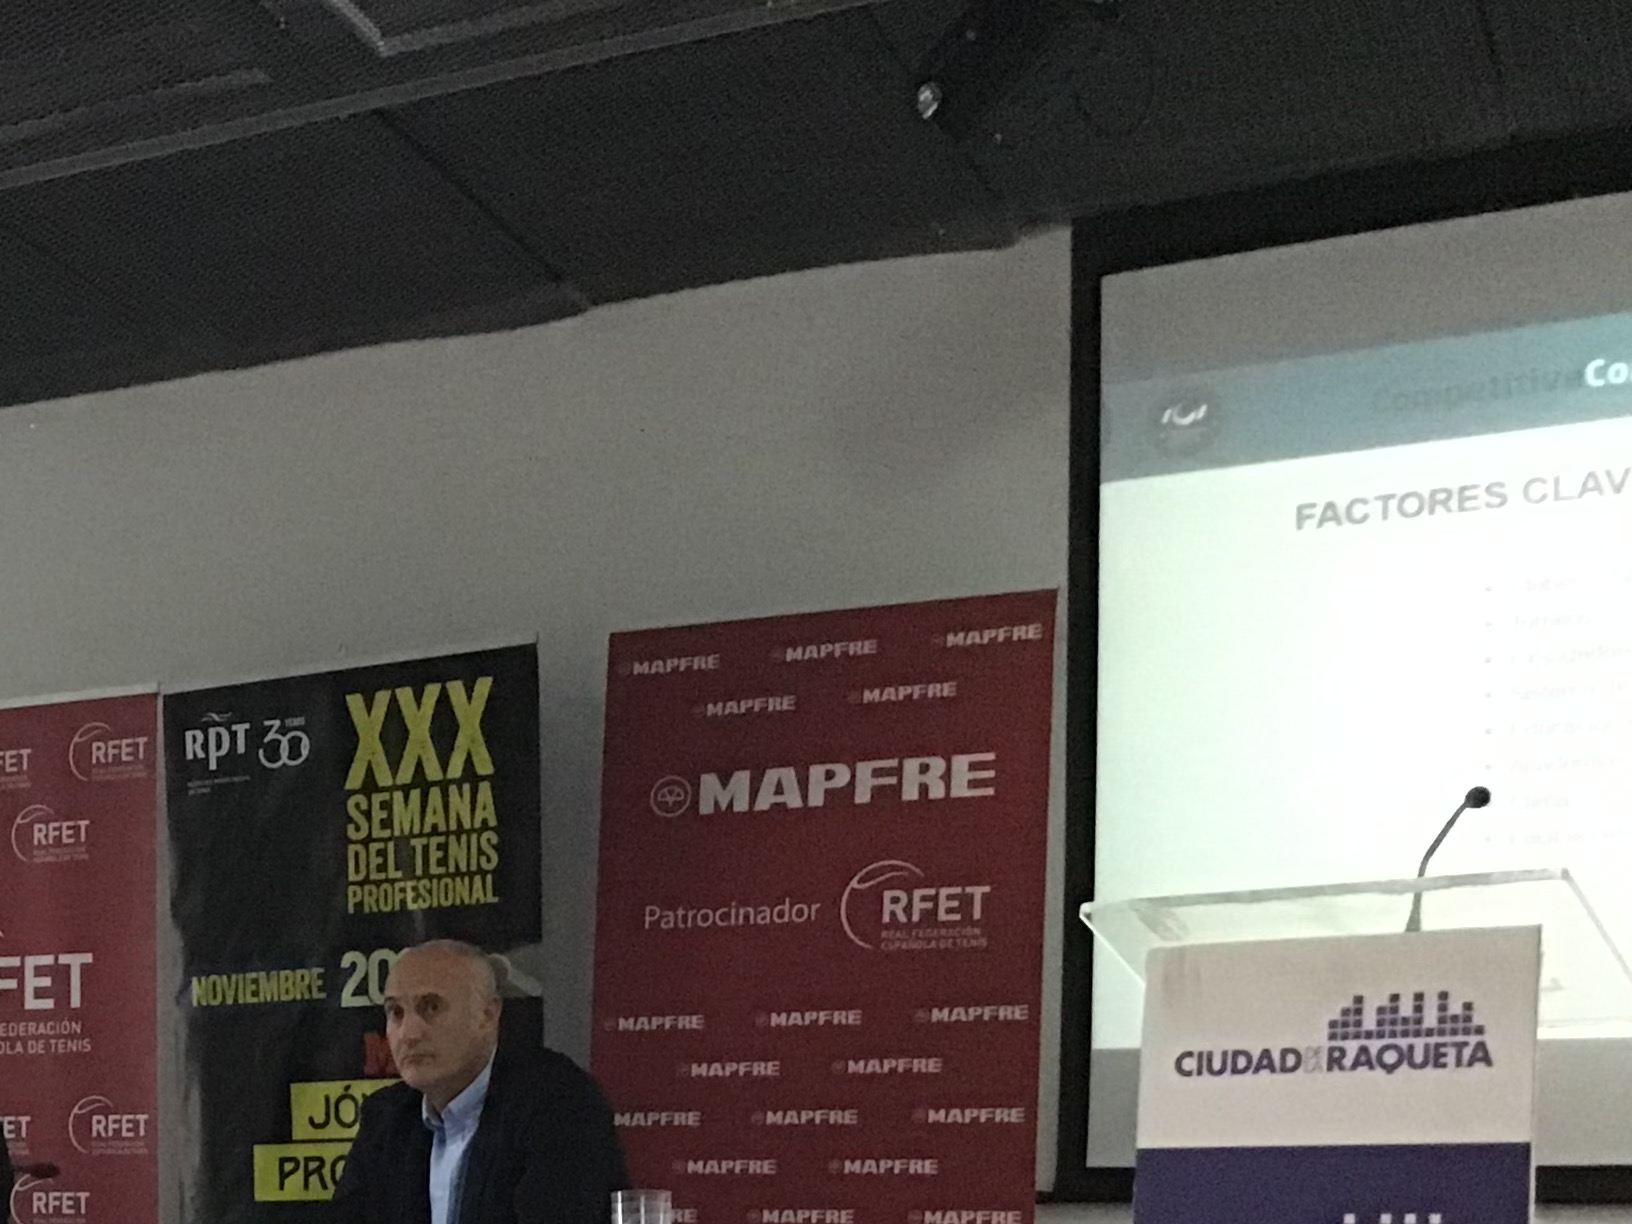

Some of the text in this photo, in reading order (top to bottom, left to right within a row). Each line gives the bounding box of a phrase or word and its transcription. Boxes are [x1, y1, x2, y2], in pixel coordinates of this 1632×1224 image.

[1584, 358, 1632, 388] Co
[1295, 466, 1632, 531] FACTORES CLAV
[947, 623, 1042, 648] MAPFRE
[786, 639, 877, 661] MAPFRE
[633, 654, 720, 675] MAPFRE
[863, 681, 957, 704] MAPFRE
[707, 695, 795, 717] MAPFRE
[259, 719, 310, 768] 30
[344, 676, 495, 790] XXX
[91, 737, 148, 764] RFET
[698, 752, 996, 815] MAPFRE
[346, 780, 498, 841] SEMANA
[33, 820, 90, 846] RFET
[348, 831, 499, 882] DEL TENIS
[347, 873, 499, 914] PROFESIONAL
[881, 886, 991, 924] RFET
[644, 897, 821, 930] Patrocinador
[191, 948, 404, 1008] NOVIEMBRE 20
[618, 1015, 705, 1031] MAPFRE
[771, 1010, 862, 1027] MAPFRE
[931, 1005, 1029, 1023] MAPFRE
[28, 1040, 45, 1054] DE
[49, 1038, 92, 1052] TENIS
[691, 1061, 780, 1078] MAPFRE
[847, 1058, 943, 1075] MAPFRE
[1174, 1047, 1302, 1077] CIUDAD
[1326, 1041, 1493, 1074] RAQUETA
[91, 1114, 149, 1137] RFET
[614, 1111, 701, 1127] MAPFRE
[765, 1110, 858, 1126] MAPFRE
[927, 1108, 1025, 1124] MAPFRE
[687, 1160, 777, 1176] MAPFRE
[843, 1159, 938, 1175] MAPFRE
[32, 1192, 90, 1214] RFET
[762, 1209, 854, 1224] MAPFRE
